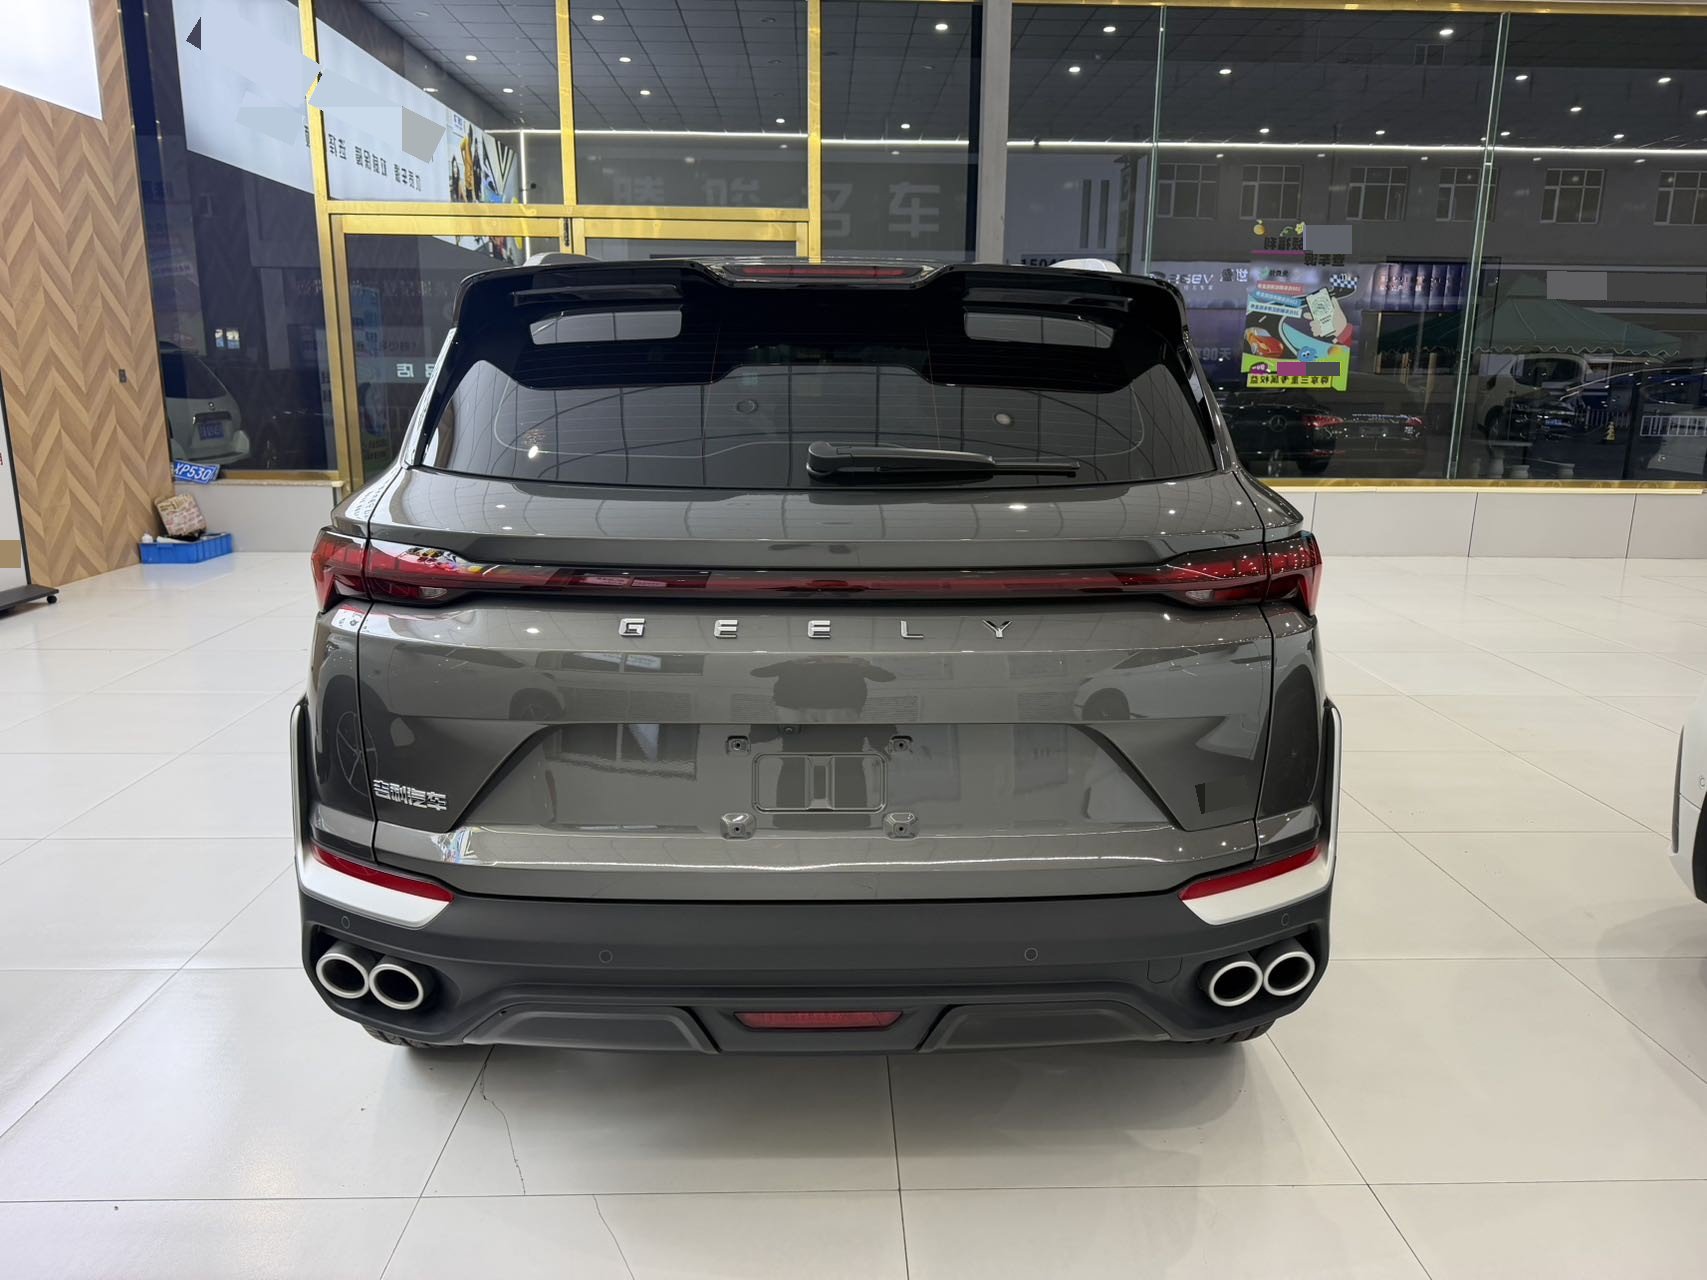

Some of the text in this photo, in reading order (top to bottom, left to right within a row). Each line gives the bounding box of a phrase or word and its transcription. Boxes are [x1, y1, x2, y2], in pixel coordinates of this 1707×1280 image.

[618, 617, 1013, 639] GEELY
[373, 779, 448, 812] 吉利汽车
